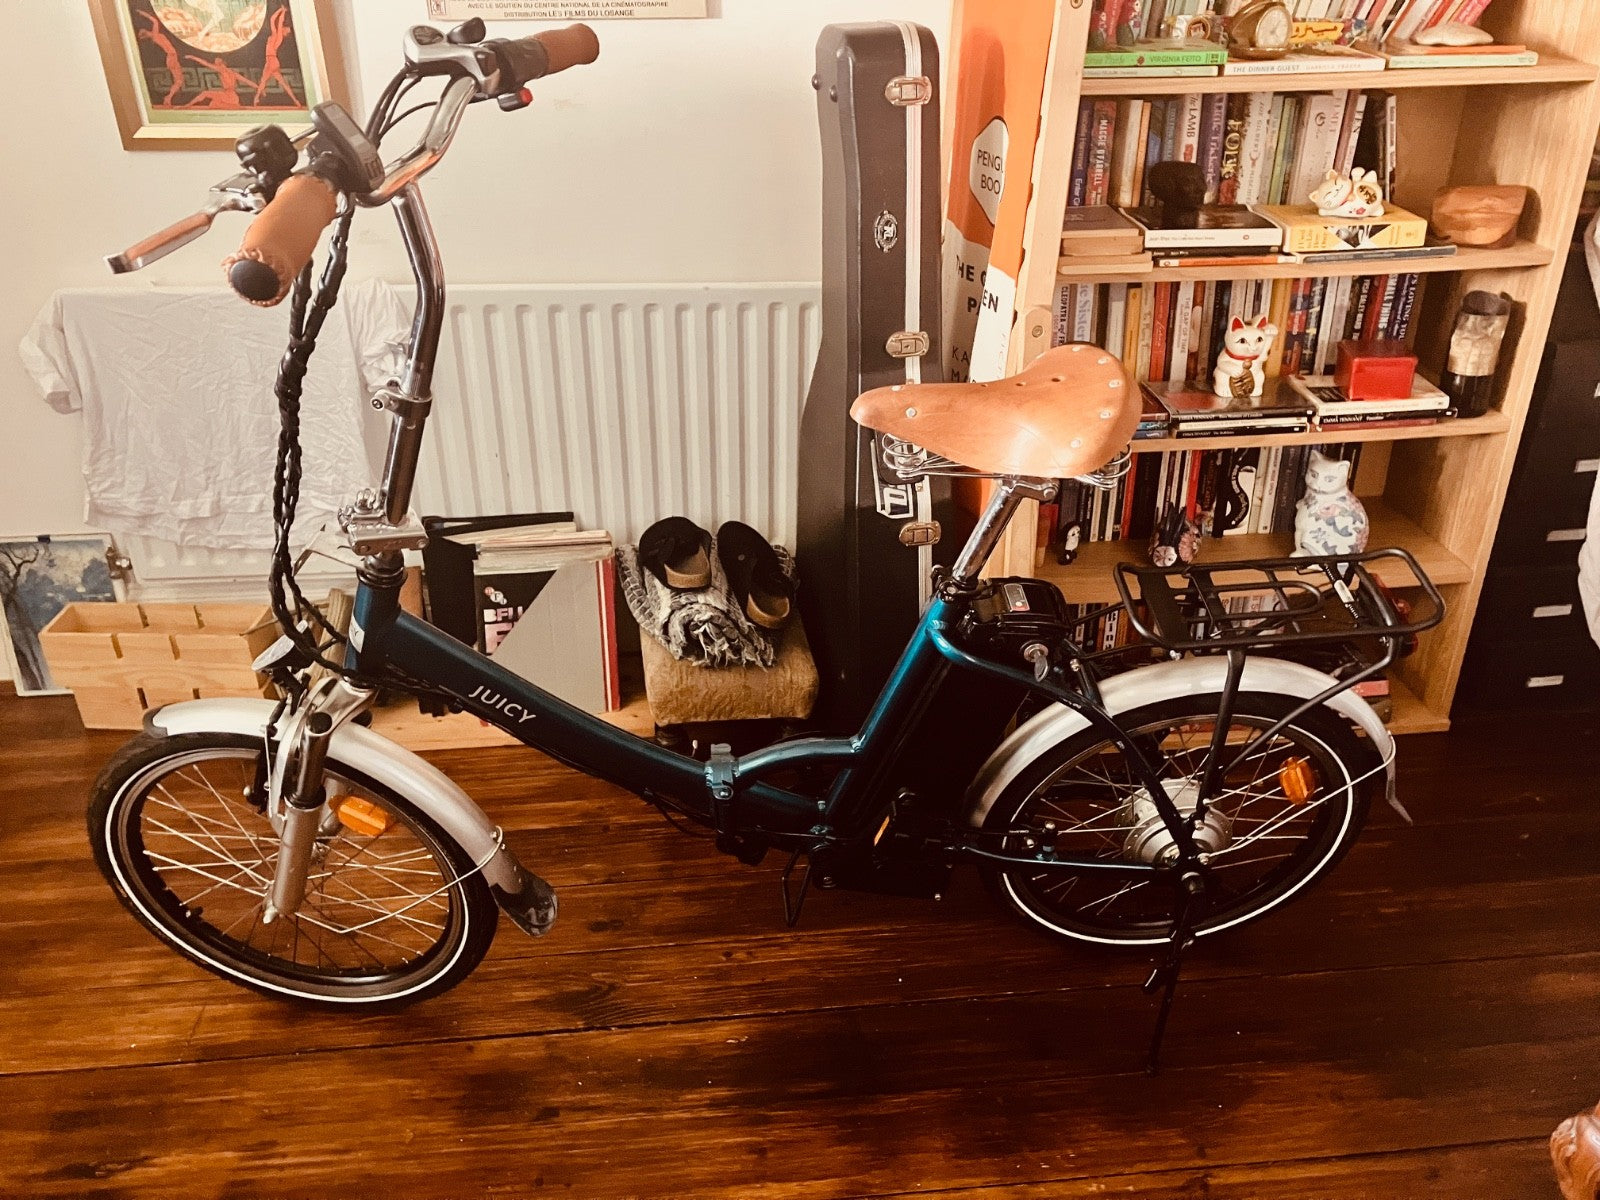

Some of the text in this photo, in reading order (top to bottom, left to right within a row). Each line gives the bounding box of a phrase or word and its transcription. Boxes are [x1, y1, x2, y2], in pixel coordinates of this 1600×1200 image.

[564, 9, 586, 17] FILMS
[600, 9, 635, 17] LOSANGE
[1149, 55, 1181, 63] VIRGINIA
[1248, 65, 1275, 73] DINNER
[1098, 119, 1108, 147] MAGGIE
[1186, 107, 1198, 138] LAMB
[980, 173, 1001, 195] BOO
[1059, 286, 1069, 323] CLEOPATRA
[1403, 286, 1416, 321] LOVING
[1076, 300, 1091, 341] Sister
[951, 345, 971, 366] KA
[468, 685, 537, 724] JUICY
